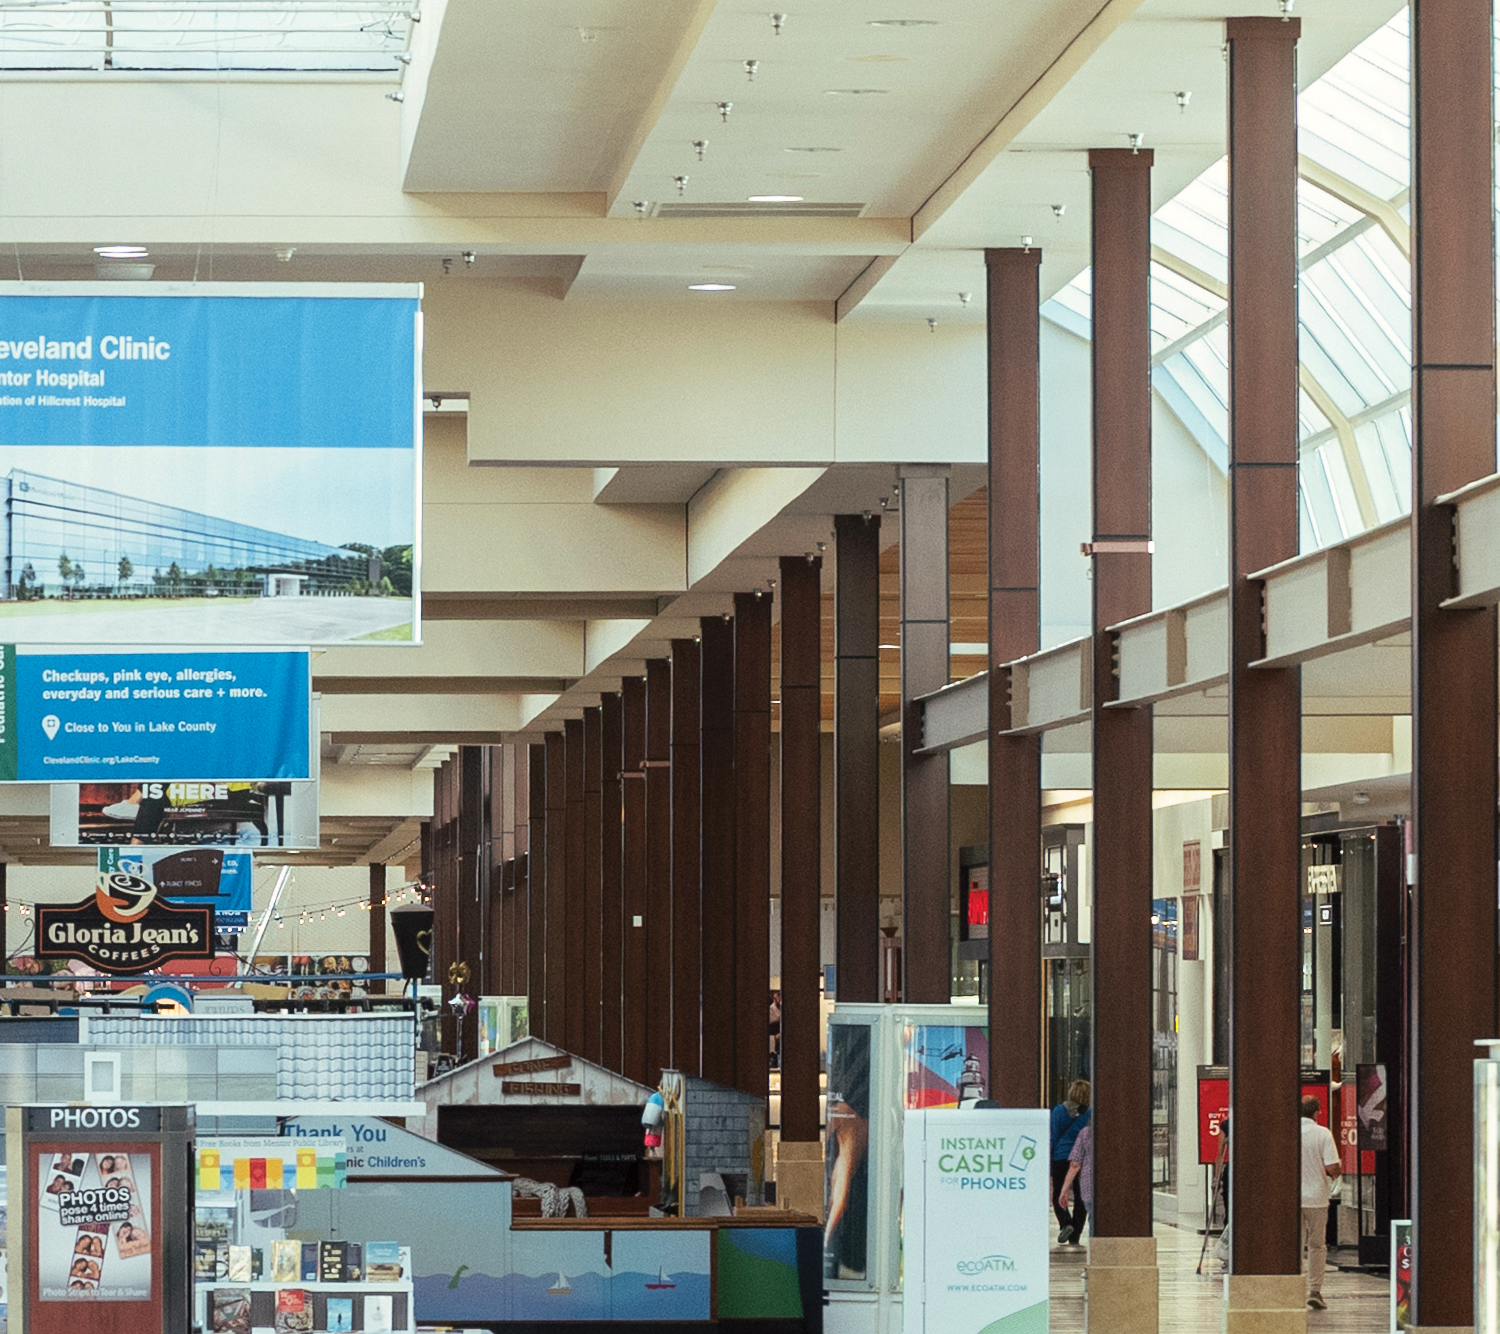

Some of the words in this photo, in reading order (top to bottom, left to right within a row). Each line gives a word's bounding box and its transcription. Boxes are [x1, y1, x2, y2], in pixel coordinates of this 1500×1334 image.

[100, 335, 171, 361] Clinic
[36, 369, 105, 390] Hospital
[24, 395, 36, 406] of
[38, 395, 80, 406] Hillcrest
[83, 395, 126, 409] Hospital
[42, 669, 110, 685] Checkups,
[113, 669, 142, 685] pink
[145, 671, 172, 685] eye,
[176, 668, 237, 684] allergies,
[42, 687, 102, 702] everyday
[105, 687, 130, 699] and
[132, 687, 180, 699] serious
[183, 688, 213, 699] care
[229, 688, 268, 699] more.
[64, 721, 96, 734] Close
[97, 722, 109, 733] to
[111, 721, 132, 733] You
[134, 721, 146, 733] in
[148, 720, 175, 733] Lake
[177, 720, 217, 735] County
[142, 783, 164, 800] IS
[169, 783, 229, 800] HERE
[48, 921, 127, 945] Gloria
[129, 921, 200, 945] Jean's
[87, 943, 161, 962] COFFEES
[509, 1083, 572, 1095] FISHING
[50, 1108, 141, 1129] PHOTOS
[286, 1124, 344, 1138] Thank
[351, 1124, 387, 1142] You
[218, 1139, 242, 1148] Books
[263, 1139, 292, 1148] Mentor
[293, 1139, 317, 1148] Public
[317, 1139, 346, 1149] Library
[940, 1137, 1006, 1150] INSTANT
[367, 1155, 426, 1168] Children's
[938, 1154, 1004, 1173] CASH
[940, 1176, 959, 1185] FOR
[960, 1177, 1027, 1190] PHONES
[59, 1187, 131, 1207] PHOTOS
[61, 1206, 88, 1218] pose
[90, 1204, 98, 1214] 4
[99, 1201, 130, 1213] times
[61, 1213, 94, 1225] share
[95, 1210, 129, 1223] online
[42, 1287, 67, 1298] Photo
[946, 1284, 1027, 1292] WWW.ECOATM.COM
